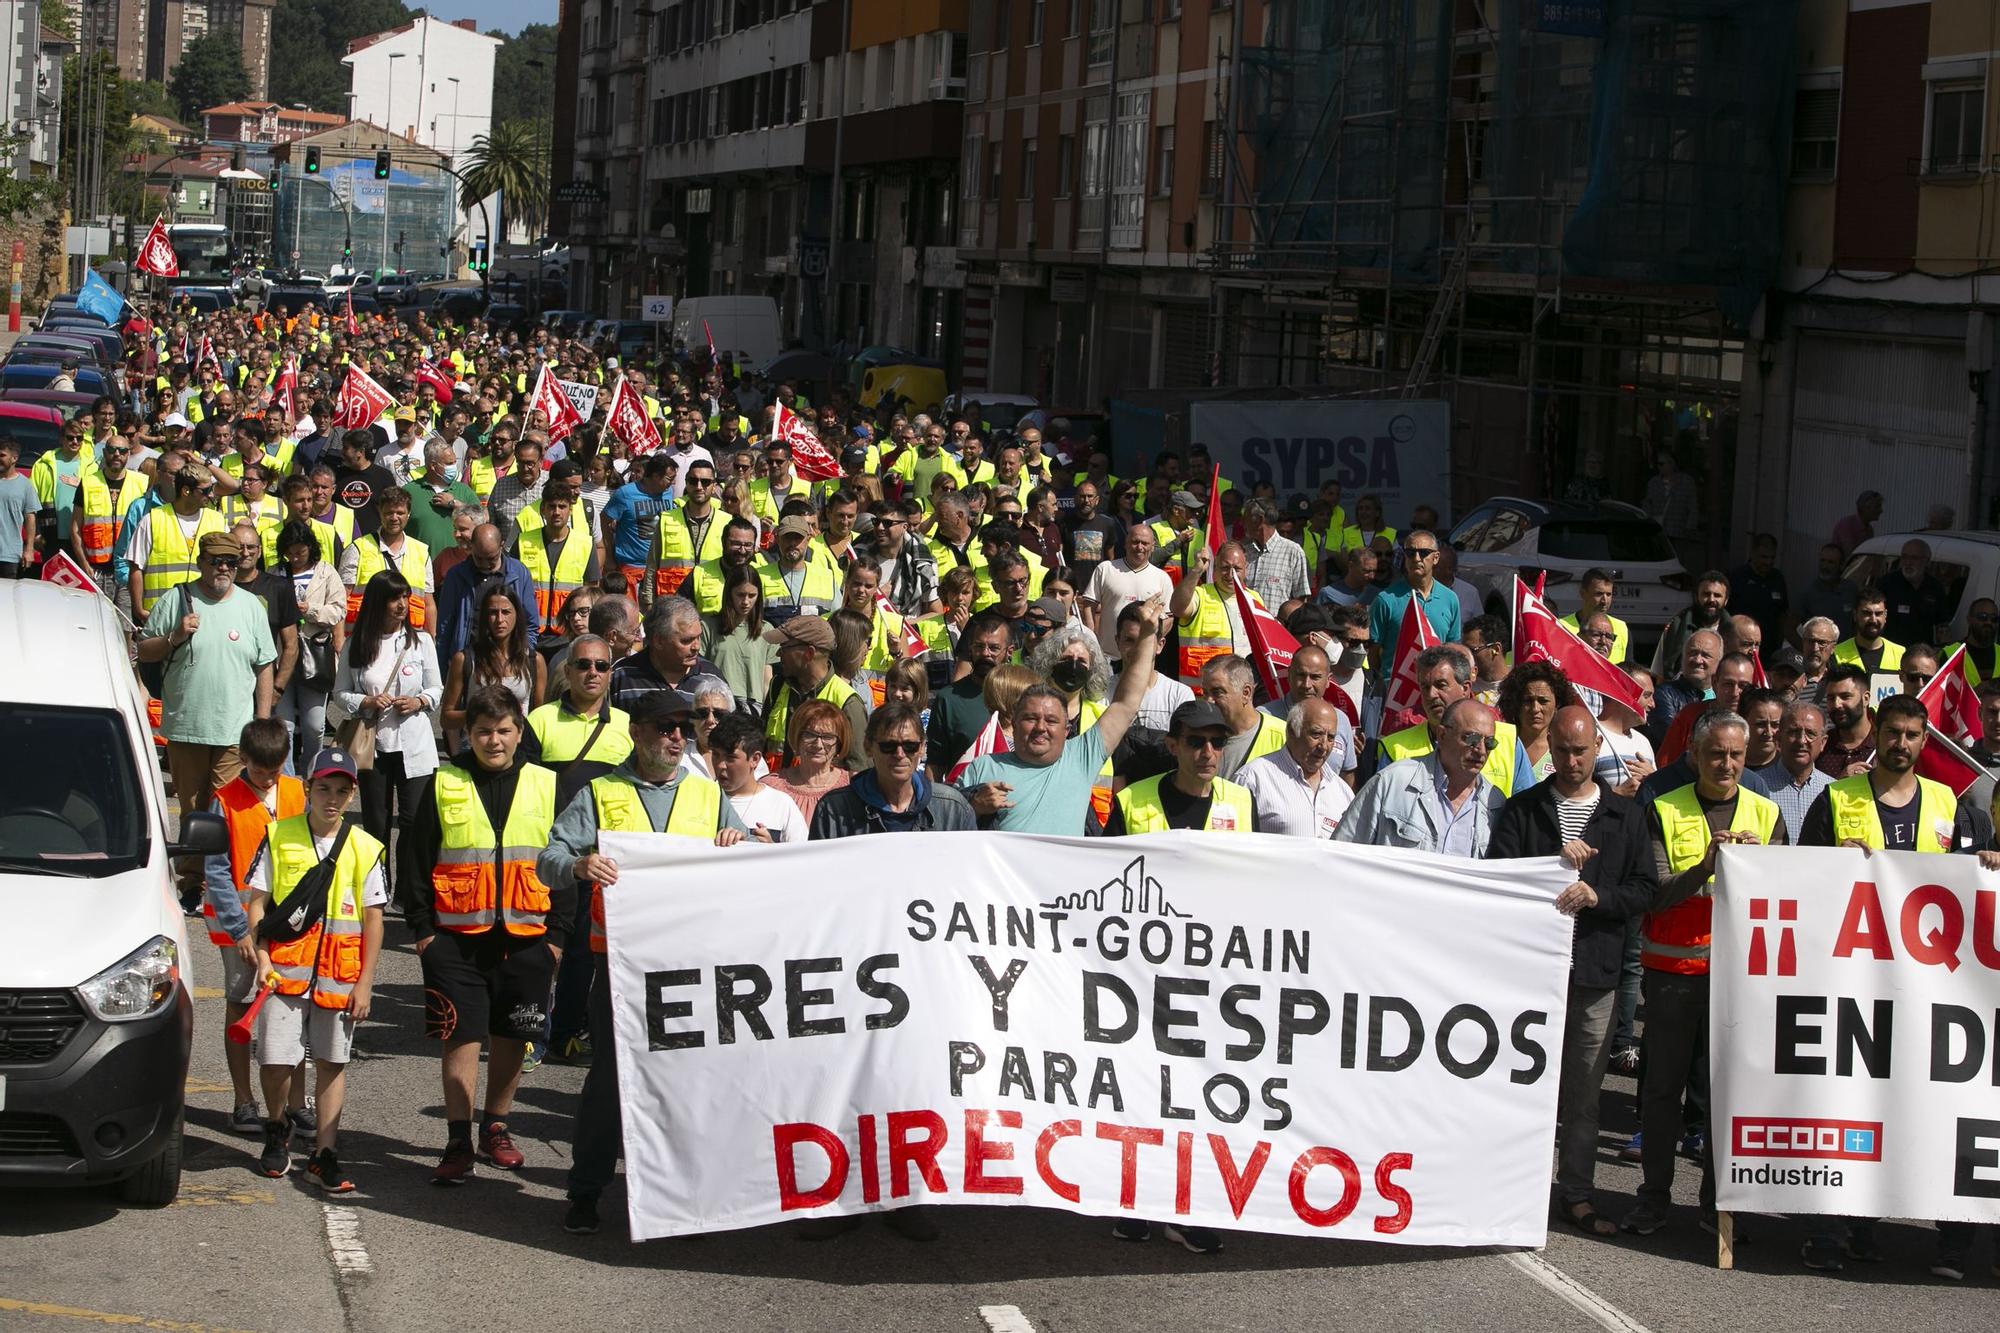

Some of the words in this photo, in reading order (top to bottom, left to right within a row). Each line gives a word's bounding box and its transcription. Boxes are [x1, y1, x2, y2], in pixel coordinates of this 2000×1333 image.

[238, 180, 270, 190] ROC
[560, 188, 599, 196] HOTEL
[650, 304, 665, 315] 42
[579, 388, 595, 399] NO
[1241, 436, 1401, 489] SYPSA
[908, 899, 1311, 974] SAINT-GOBAIN
[645, 953, 911, 1053] ERES
[968, 954, 1029, 1033] Y
[1083, 971, 1547, 1086] DESPIDOS
[1775, 995, 1894, 1079] EN
[1930, 1003, 2000, 1087] D
[949, 1040, 1125, 1112] PARA
[1160, 1064, 1292, 1132] LOS
[1741, 1124, 1840, 1151] CCOO
[1953, 1116, 2000, 1199] E
[773, 1109, 1414, 1235] DIRECTIVOS
[1731, 1162, 1844, 1188] industria
